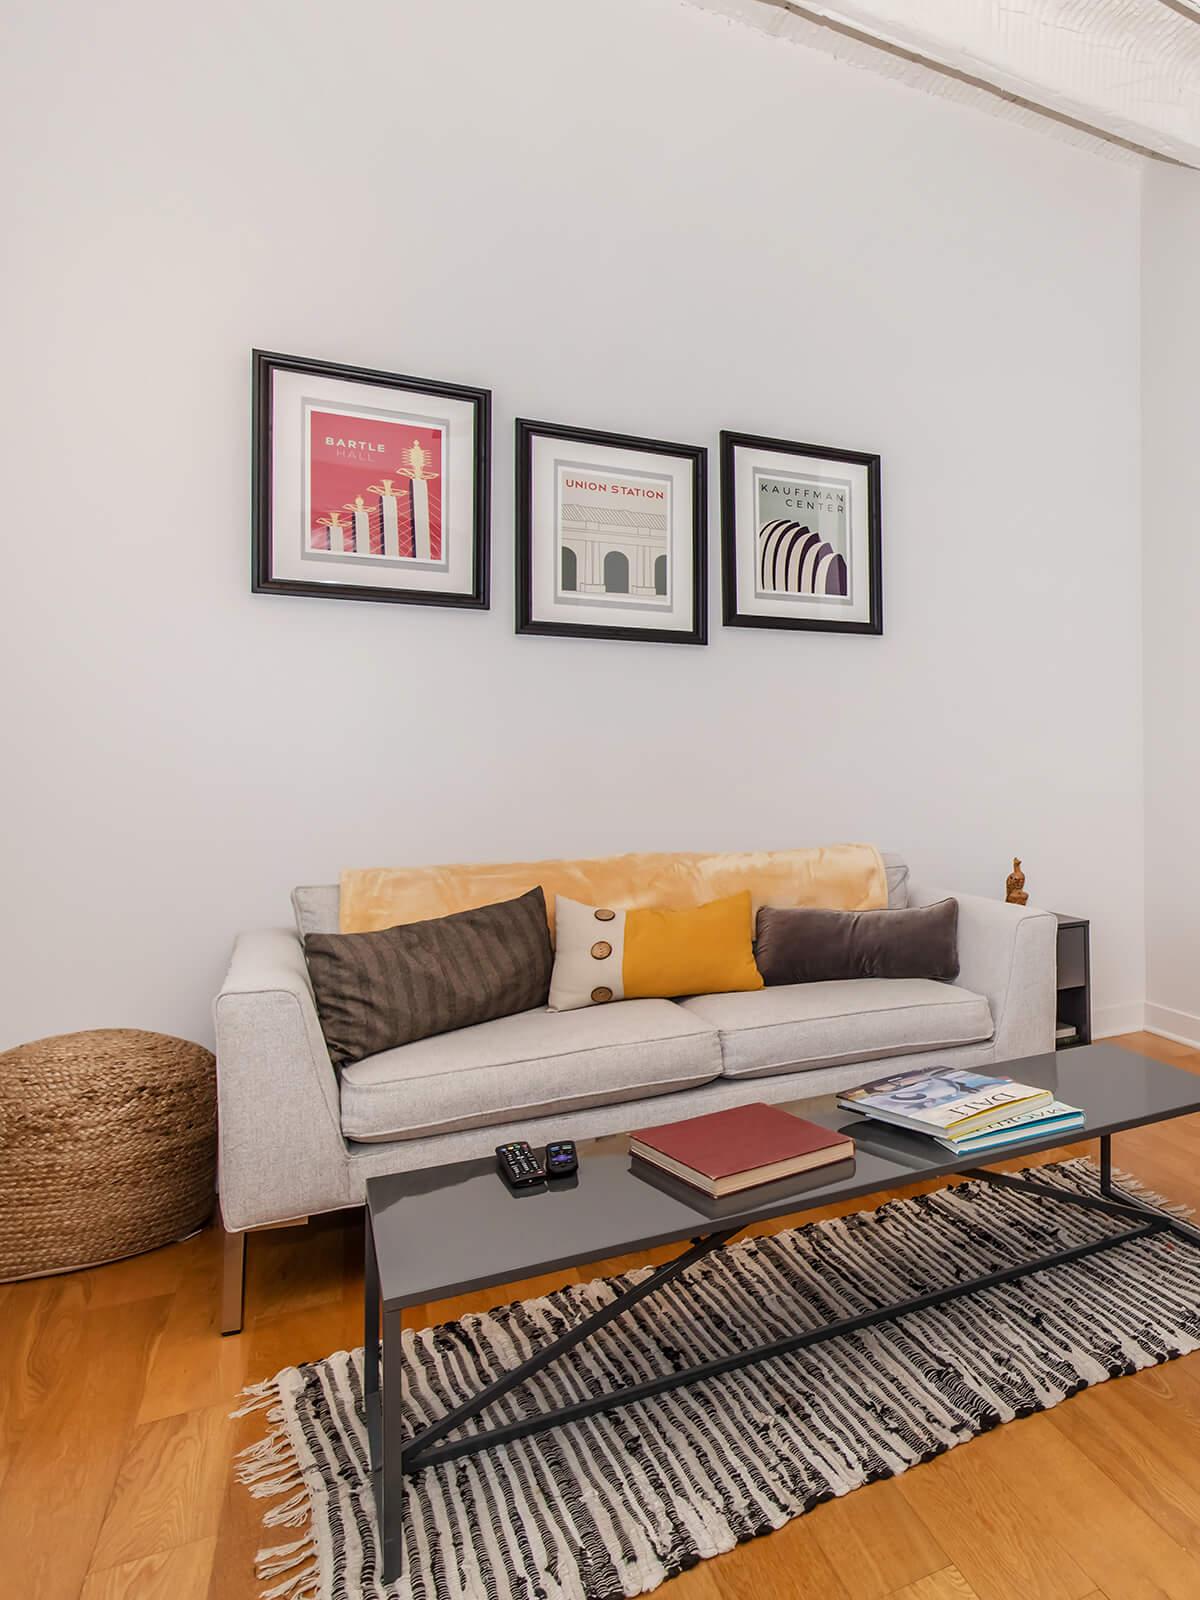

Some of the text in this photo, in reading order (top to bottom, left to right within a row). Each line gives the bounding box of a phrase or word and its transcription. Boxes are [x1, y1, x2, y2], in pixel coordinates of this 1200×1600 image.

[325, 436, 385, 453] BARTLE
[336, 447, 377, 463] HALL
[565, 479, 664, 500] UNION STATION
[760, 483, 844, 513] KAUFFMAN CENTER
